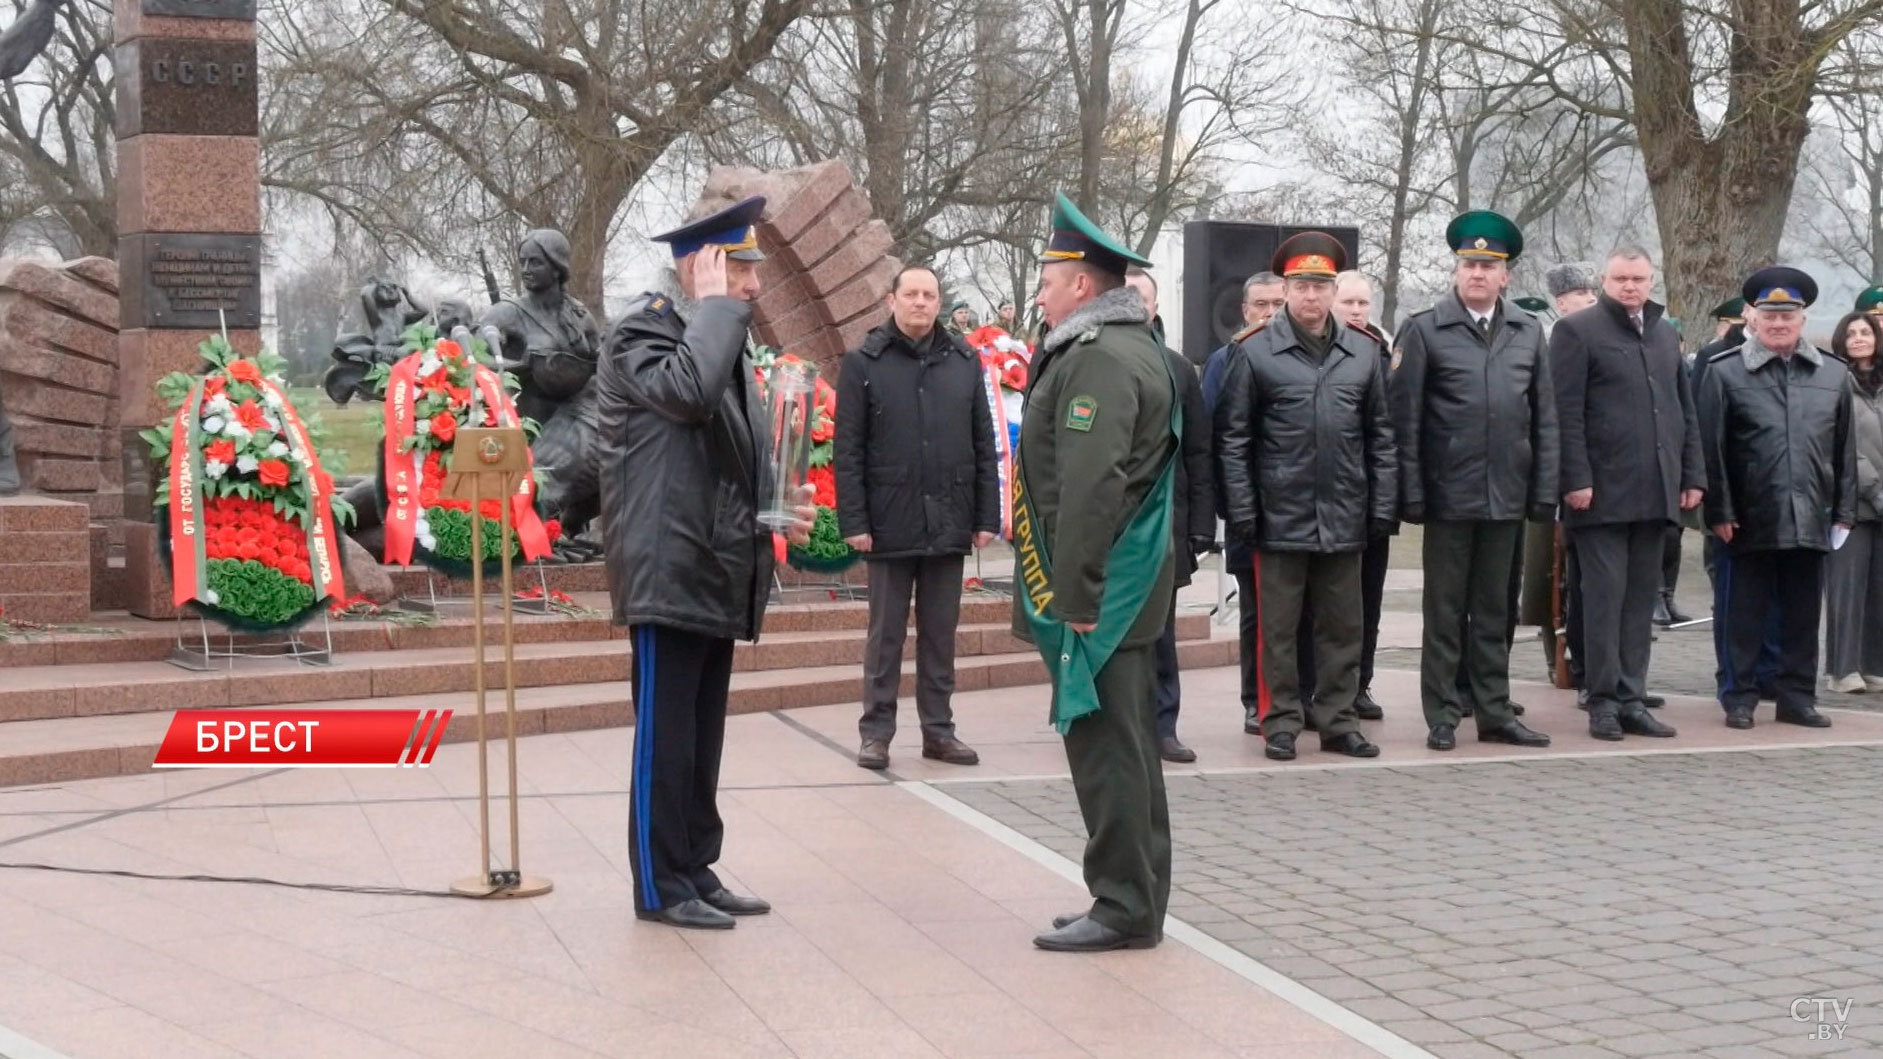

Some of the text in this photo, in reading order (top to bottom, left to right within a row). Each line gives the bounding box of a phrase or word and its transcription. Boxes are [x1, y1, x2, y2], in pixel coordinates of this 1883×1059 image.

[152, 60, 247, 86] СССР
[182, 519, 195, 535] ОТ
[1014, 505, 1054, 616] ГРУППА
